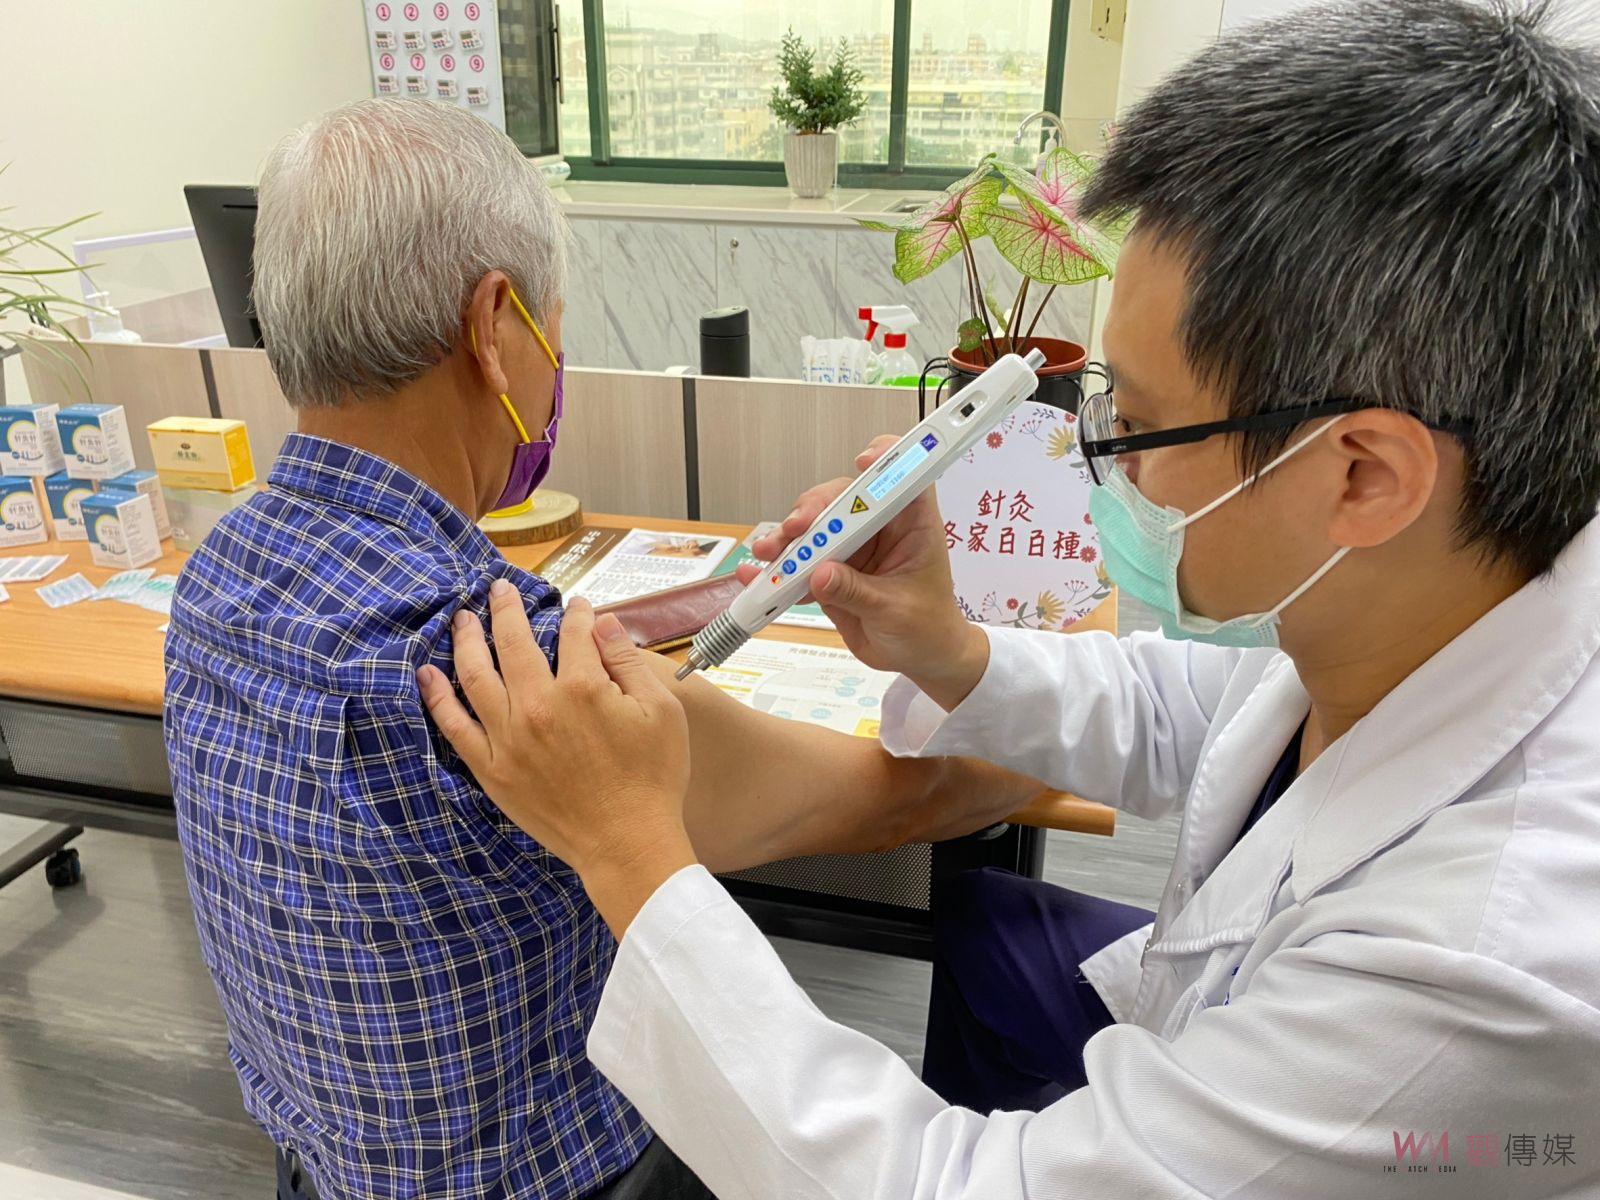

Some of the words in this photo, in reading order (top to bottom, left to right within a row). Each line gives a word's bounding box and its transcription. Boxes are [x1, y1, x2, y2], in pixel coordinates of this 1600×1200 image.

[978, 490, 1034, 522] 針灸
[944, 520, 1082, 560] 各家百百種
